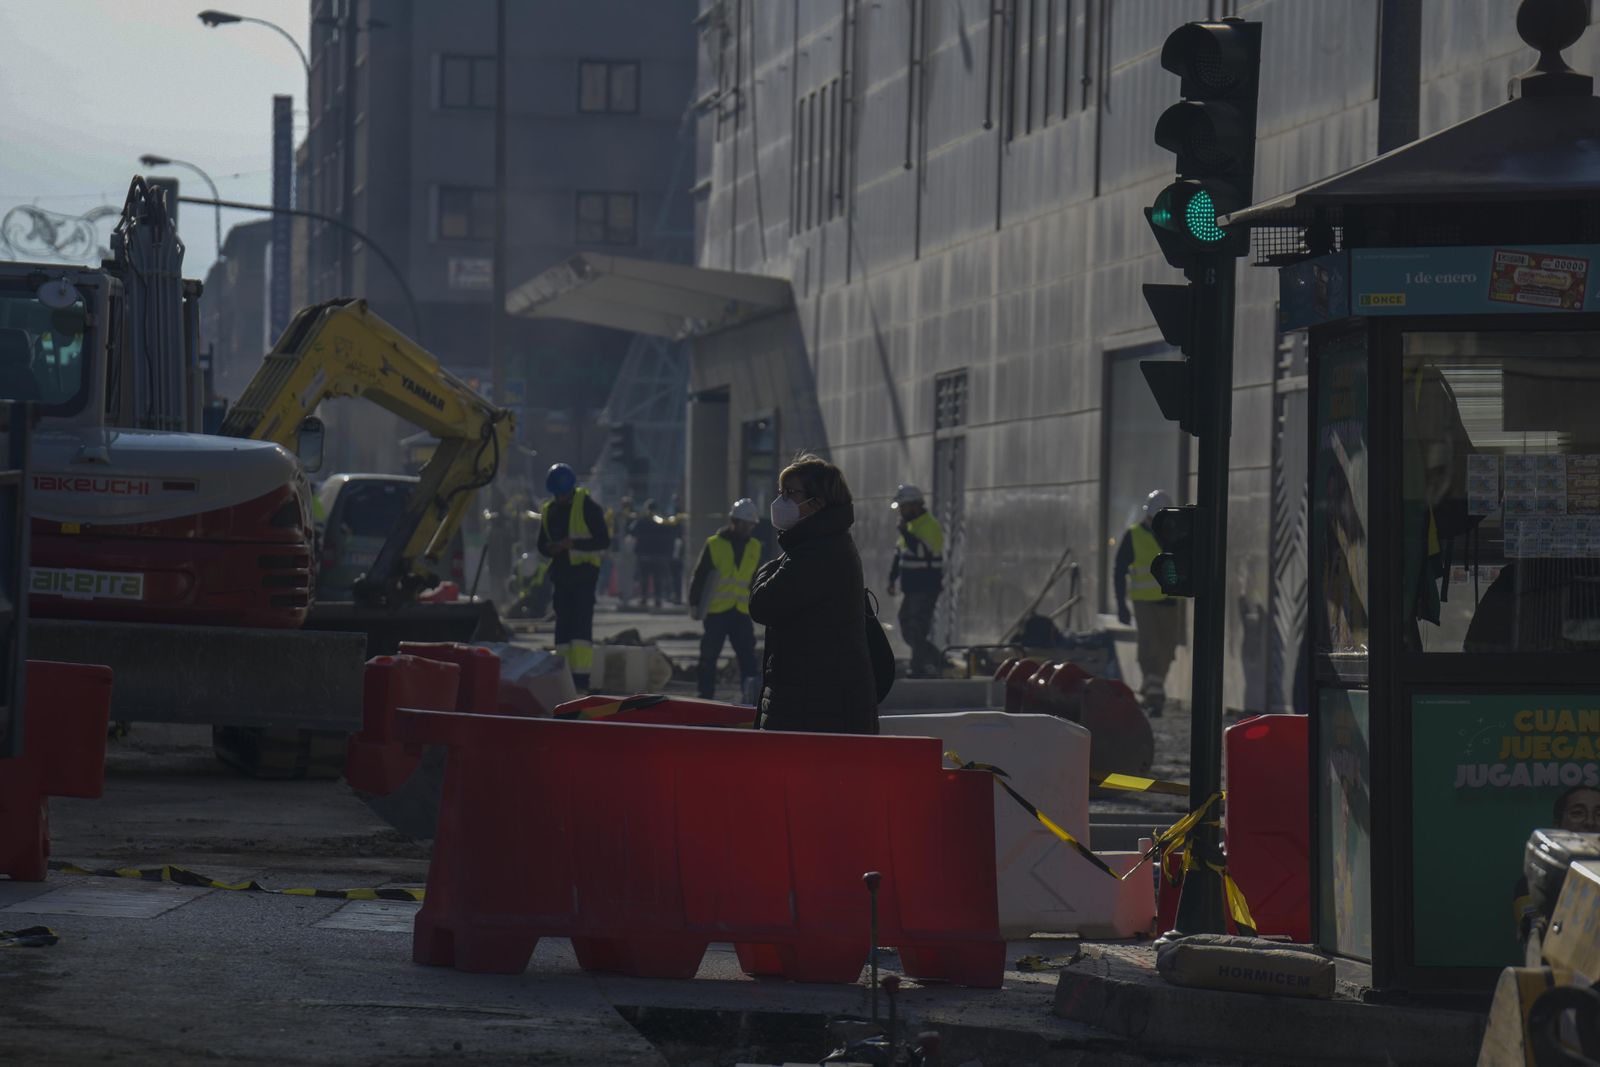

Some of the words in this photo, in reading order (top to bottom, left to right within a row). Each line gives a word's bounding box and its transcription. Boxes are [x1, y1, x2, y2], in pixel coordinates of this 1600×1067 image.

[1405, 272, 1411, 284] 1
[1414, 271, 1432, 284] de
[1435, 273, 1477, 284] enero
[1372, 295, 1404, 305] ONCE
[402, 374, 446, 412] YANMAR
[32, 570, 142, 596] alterra
[1453, 762, 1600, 788] JUGAMOS
[1218, 965, 1311, 989] HORMICEM
